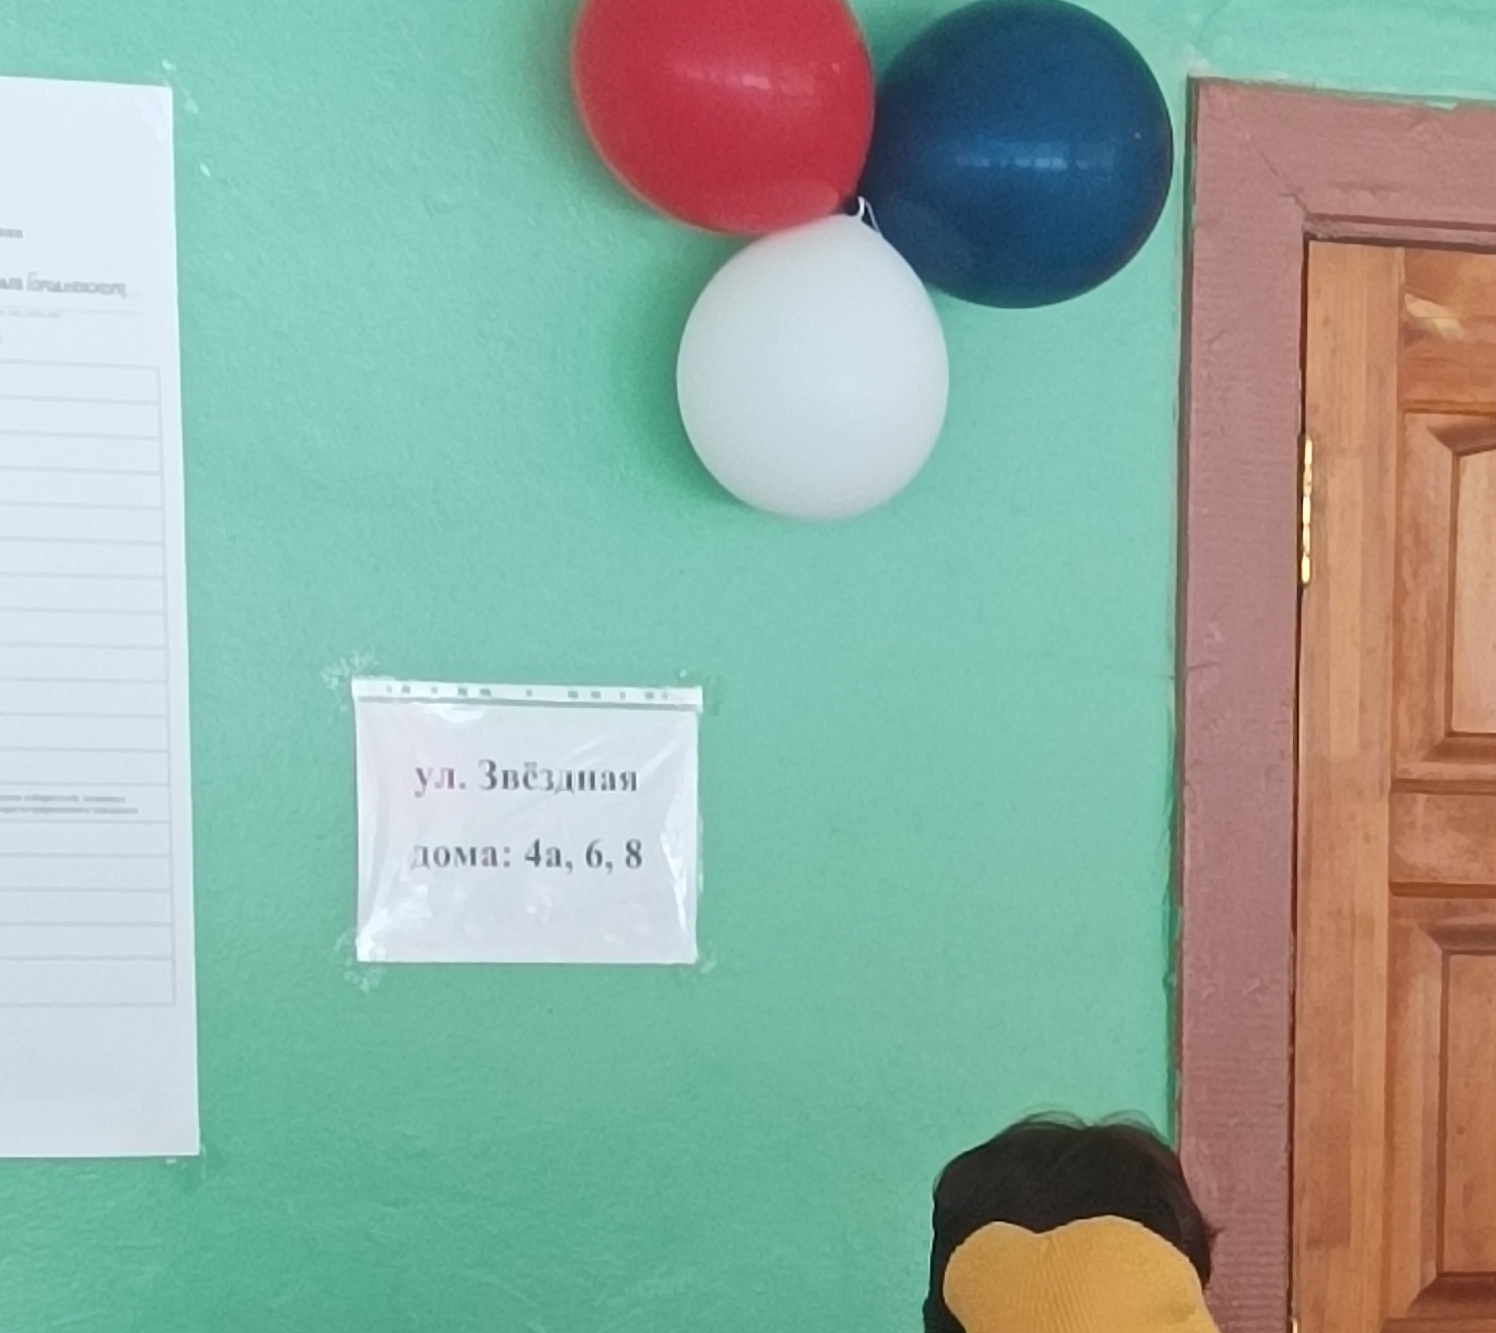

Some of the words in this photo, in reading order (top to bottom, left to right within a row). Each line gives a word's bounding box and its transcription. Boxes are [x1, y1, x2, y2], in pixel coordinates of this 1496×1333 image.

[412, 767, 467, 798] ул.
[478, 759, 638, 795] Звёздная
[410, 845, 511, 870] дома:
[524, 839, 573, 873] 4а,
[585, 839, 614, 874] 6,
[624, 839, 643, 869] 8
